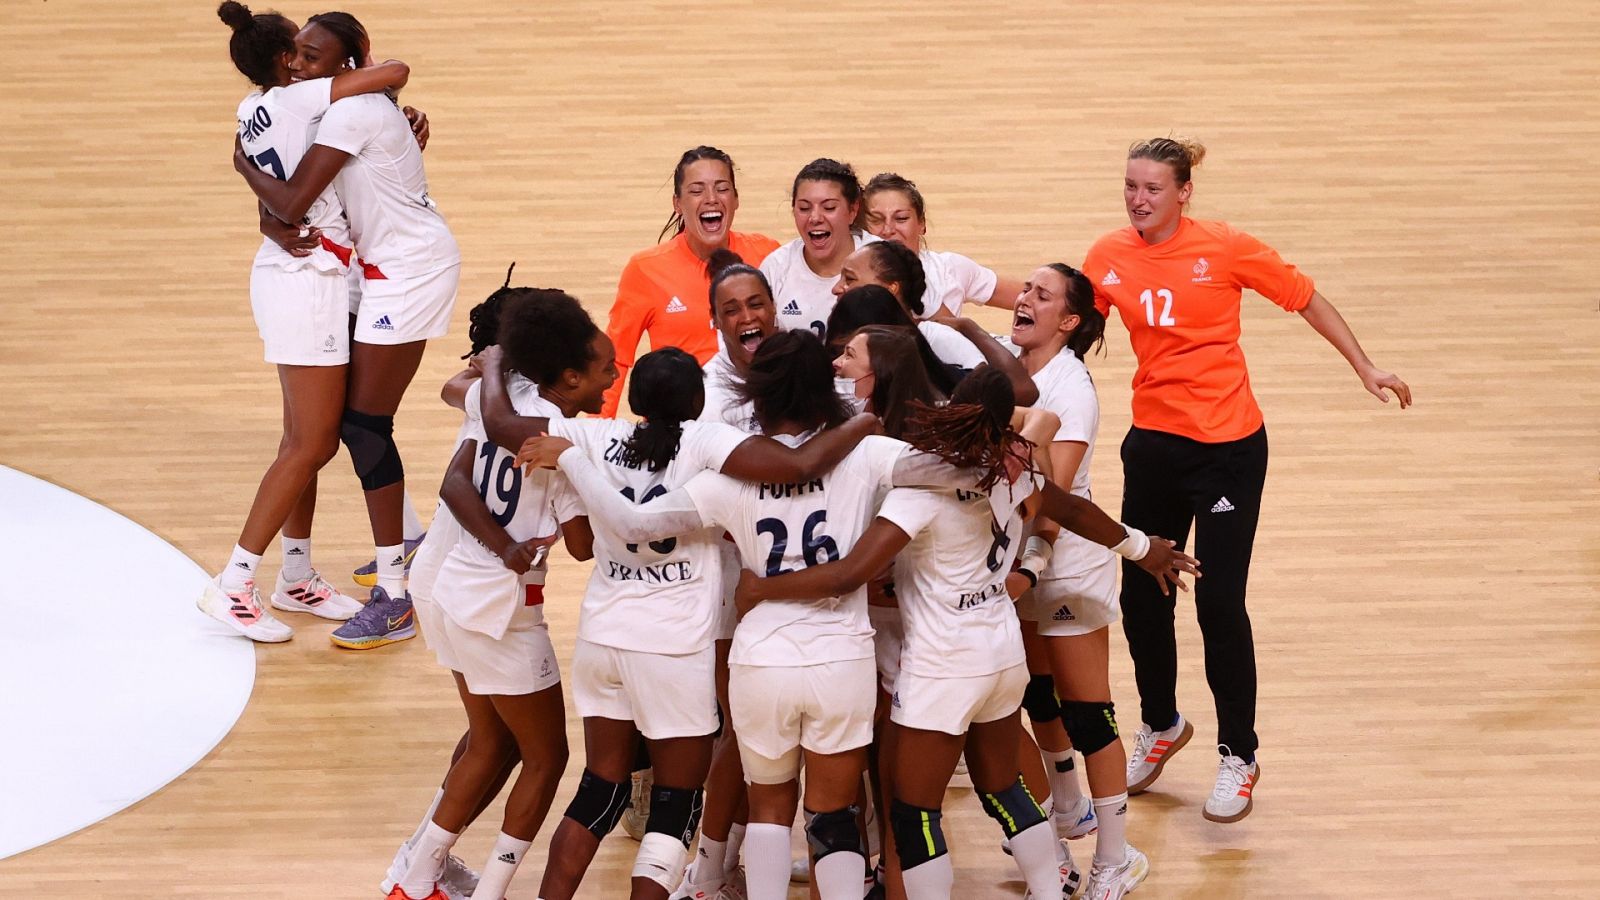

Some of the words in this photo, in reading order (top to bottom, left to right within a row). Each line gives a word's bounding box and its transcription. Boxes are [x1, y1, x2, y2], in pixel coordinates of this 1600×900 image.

[1139, 288, 1176, 327] 12
[479, 440, 522, 528] 19
[756, 509, 840, 578] 26
[608, 560, 692, 584] FRANCE
